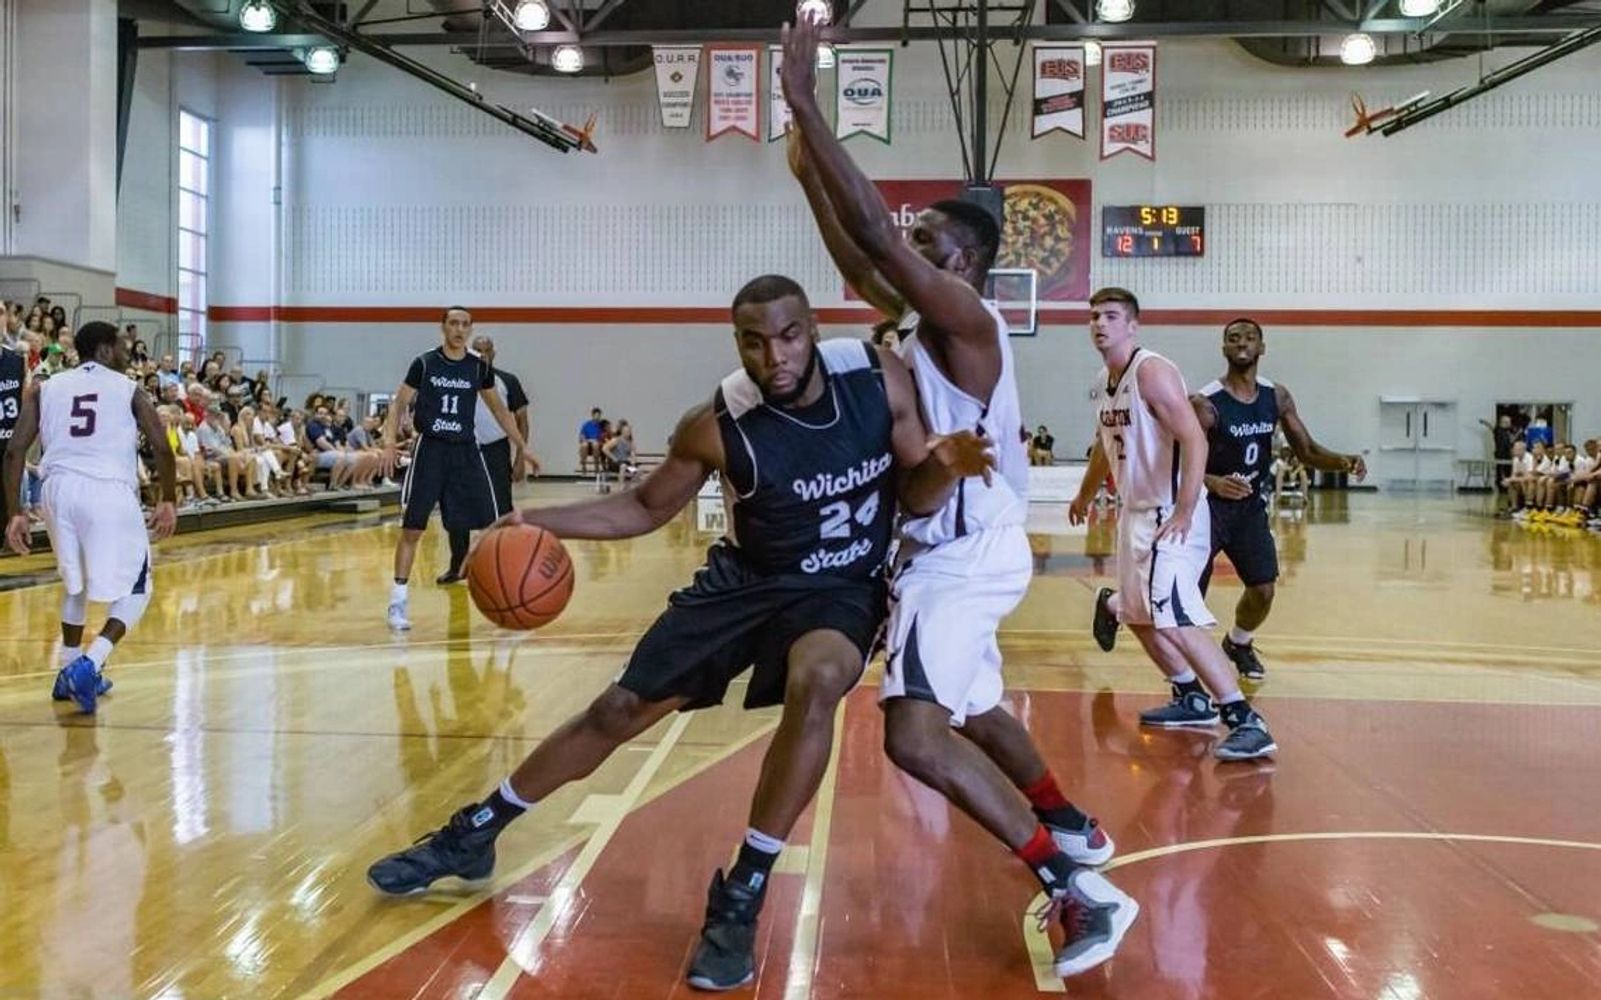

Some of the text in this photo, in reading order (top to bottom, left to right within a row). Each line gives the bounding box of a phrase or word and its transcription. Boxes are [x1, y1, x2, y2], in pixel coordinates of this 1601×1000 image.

[843, 87, 883, 97] OUA
[1141, 207, 1178, 224] 5:13
[1107, 226, 1143, 235] RAVENS
[1118, 236, 1201, 252] 12 1 7
[430, 375, 472, 389] Wichita
[441, 394, 459, 414] 11
[70, 393, 98, 437] 5
[432, 418, 462, 432] State
[1230, 421, 1274, 437] Wichita
[1245, 442, 1259, 465] 0
[793, 452, 893, 501] Wichita
[819, 490, 881, 540] 24
[801, 537, 873, 574] State
